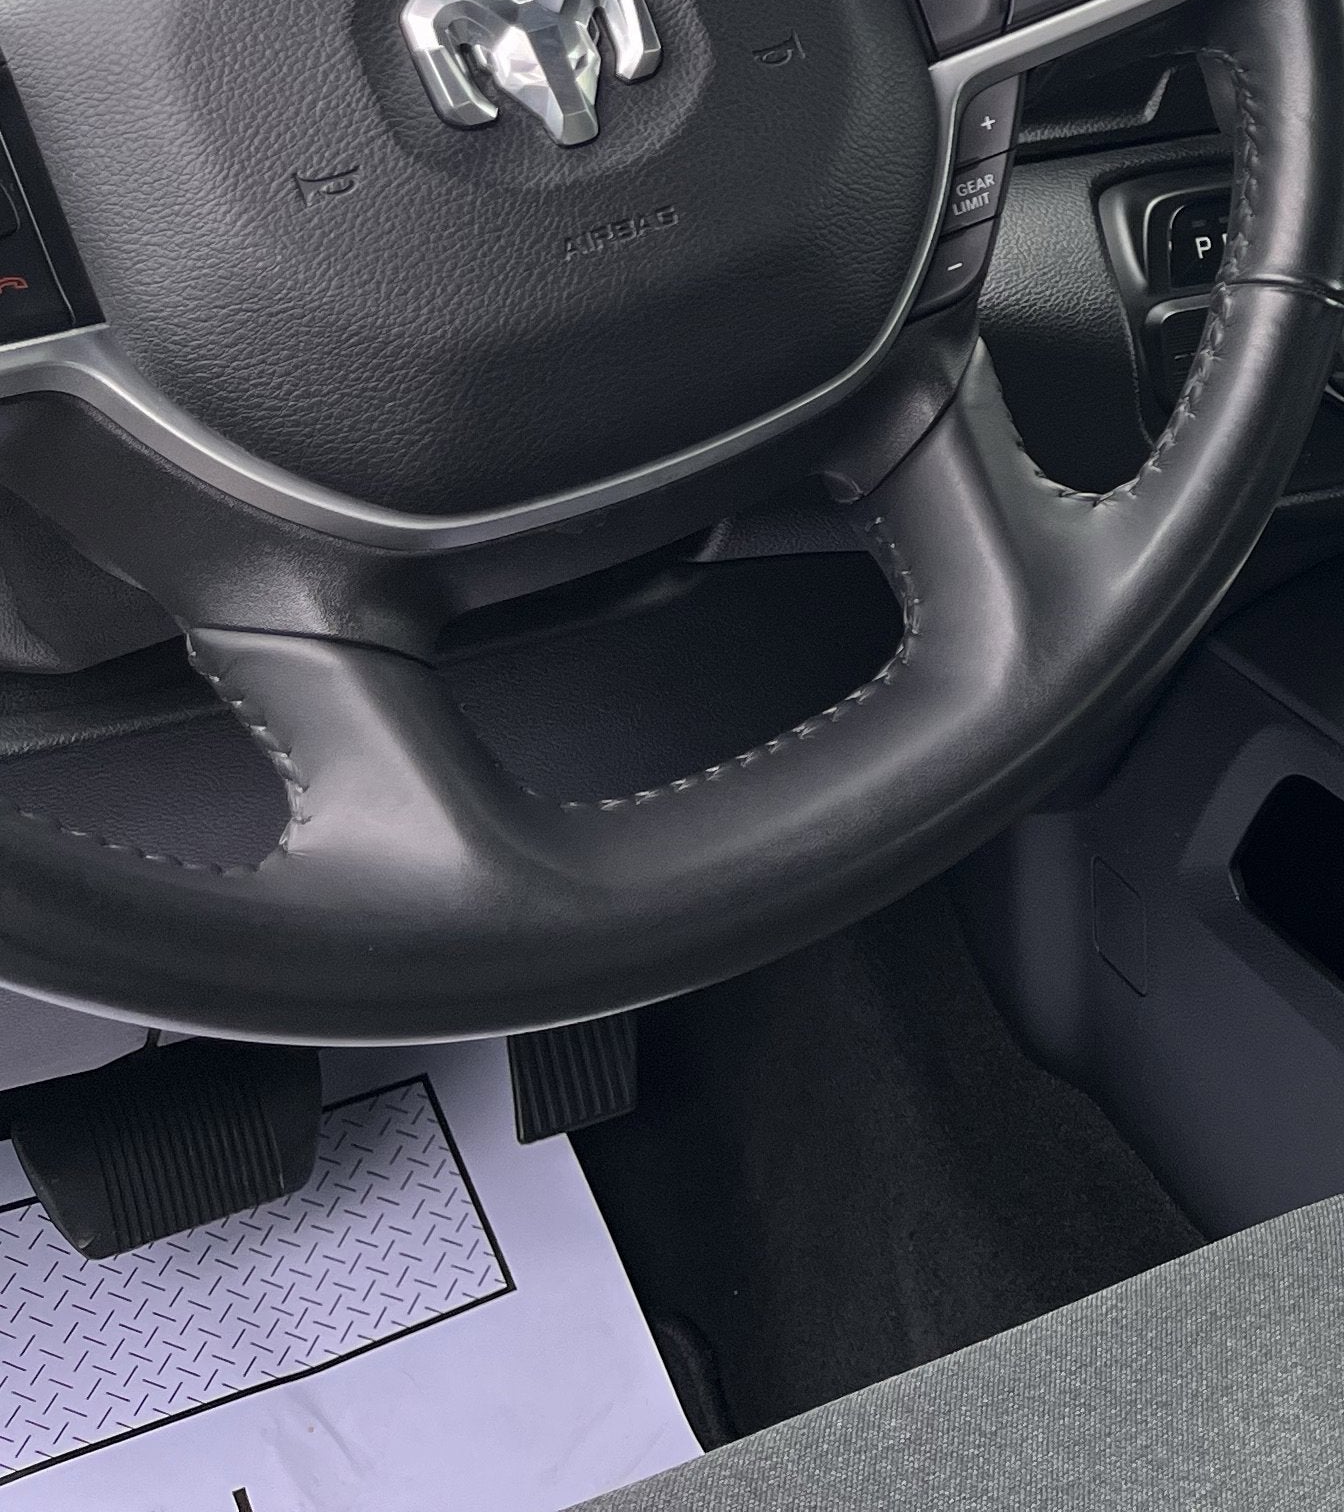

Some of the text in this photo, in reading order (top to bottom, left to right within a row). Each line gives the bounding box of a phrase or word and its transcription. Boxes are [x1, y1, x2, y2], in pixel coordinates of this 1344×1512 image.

[956, 174, 995, 197] GEAR
[952, 192, 991, 216] LIMIT
[1195, 236, 1212, 259] P
